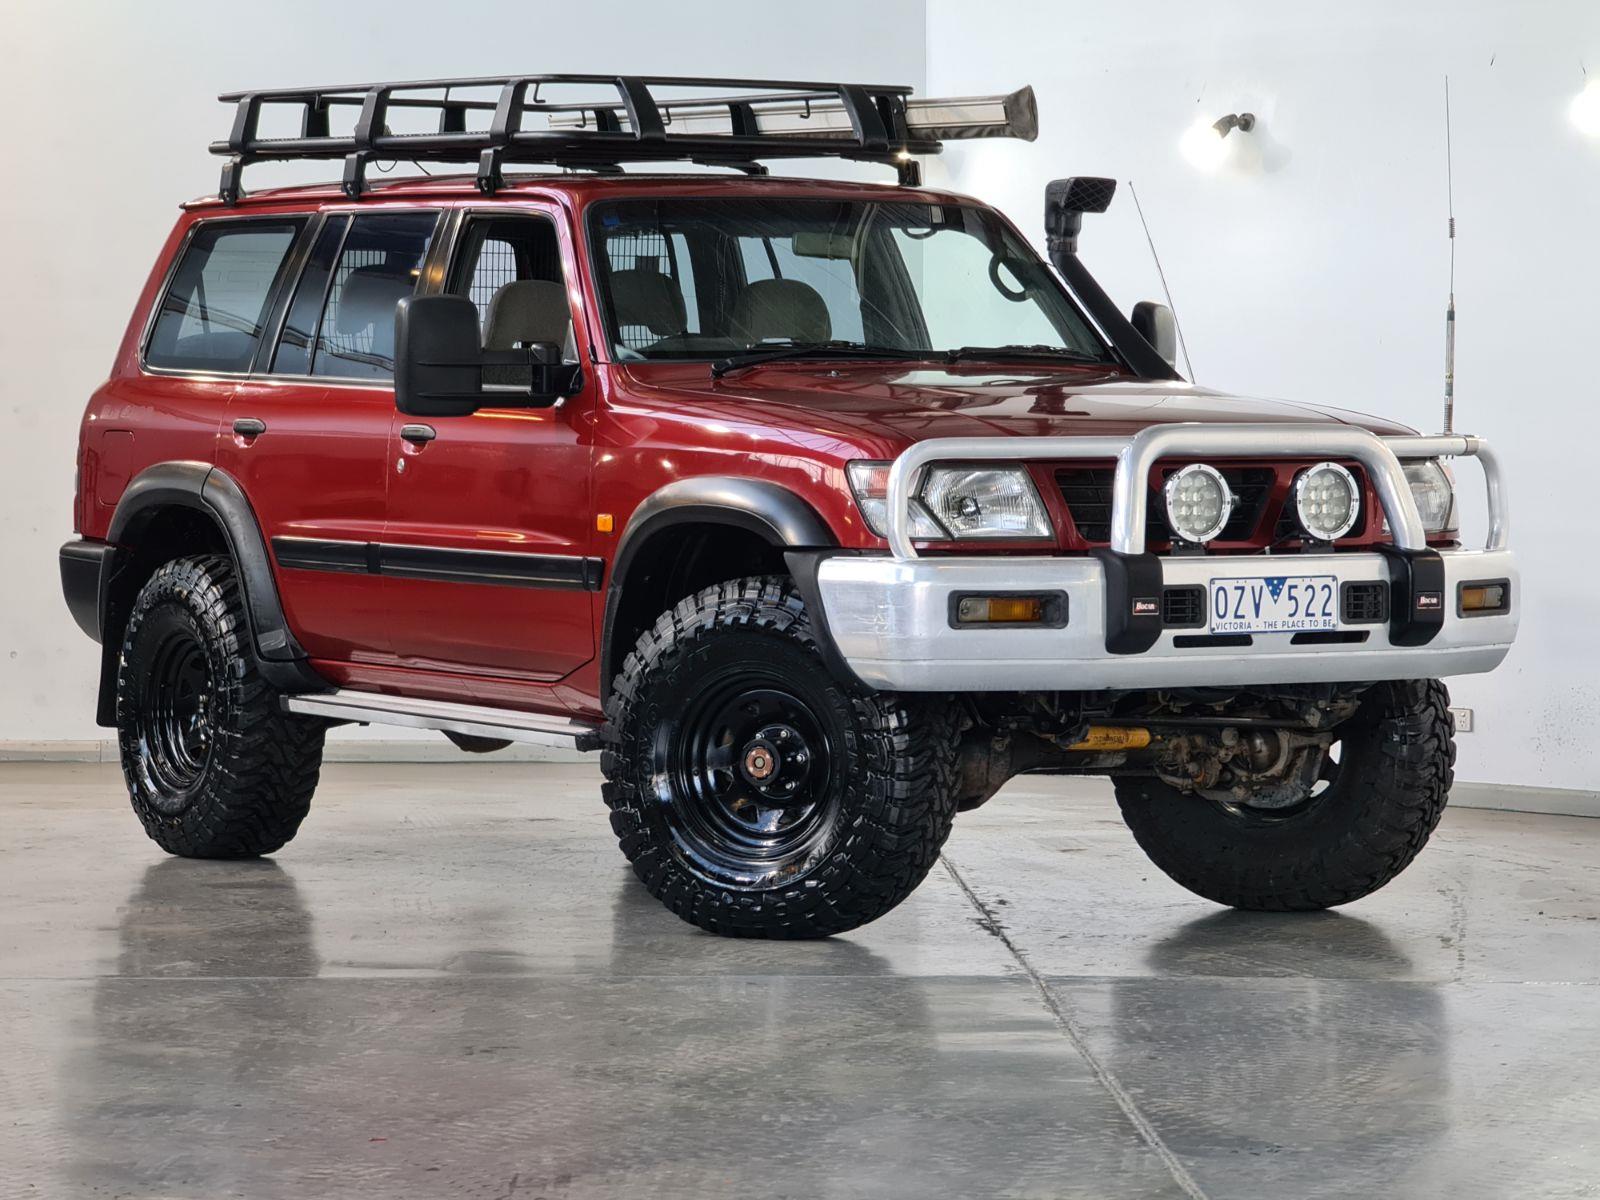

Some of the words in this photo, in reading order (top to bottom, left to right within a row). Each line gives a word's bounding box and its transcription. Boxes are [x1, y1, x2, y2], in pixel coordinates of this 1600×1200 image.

[1215, 585, 1263, 619] OZV
[1287, 584, 1332, 617] 522
[1215, 621, 1252, 630] VICTORIA
[1264, 620, 1278, 629] THE
[1281, 620, 1305, 628] PLACE
[1309, 619, 1319, 627] TO
[1322, 619, 1332, 627] BE
